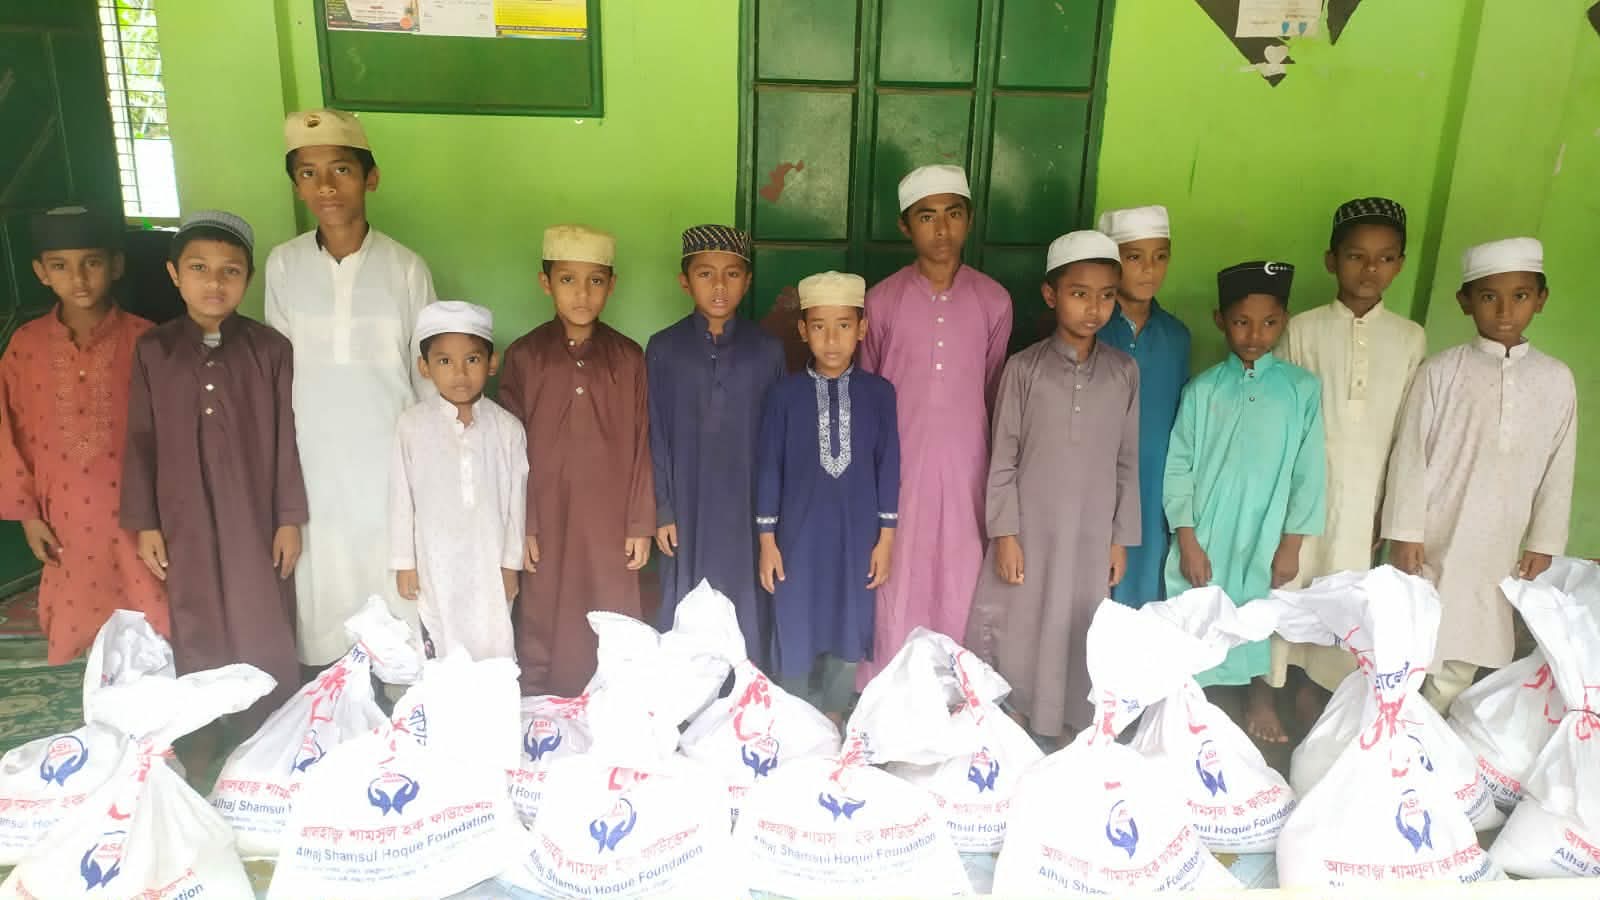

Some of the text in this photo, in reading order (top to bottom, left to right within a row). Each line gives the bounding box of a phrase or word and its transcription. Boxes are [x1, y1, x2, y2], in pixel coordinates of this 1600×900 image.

[324, 849, 378, 864] Shamsul
[382, 841, 425, 860] Hoque
[427, 812, 496, 846] Foundation
[1214, 824, 1252, 835] Hoque
[638, 844, 704, 883] Foundation
[1554, 847, 1588, 872] Alhaj
